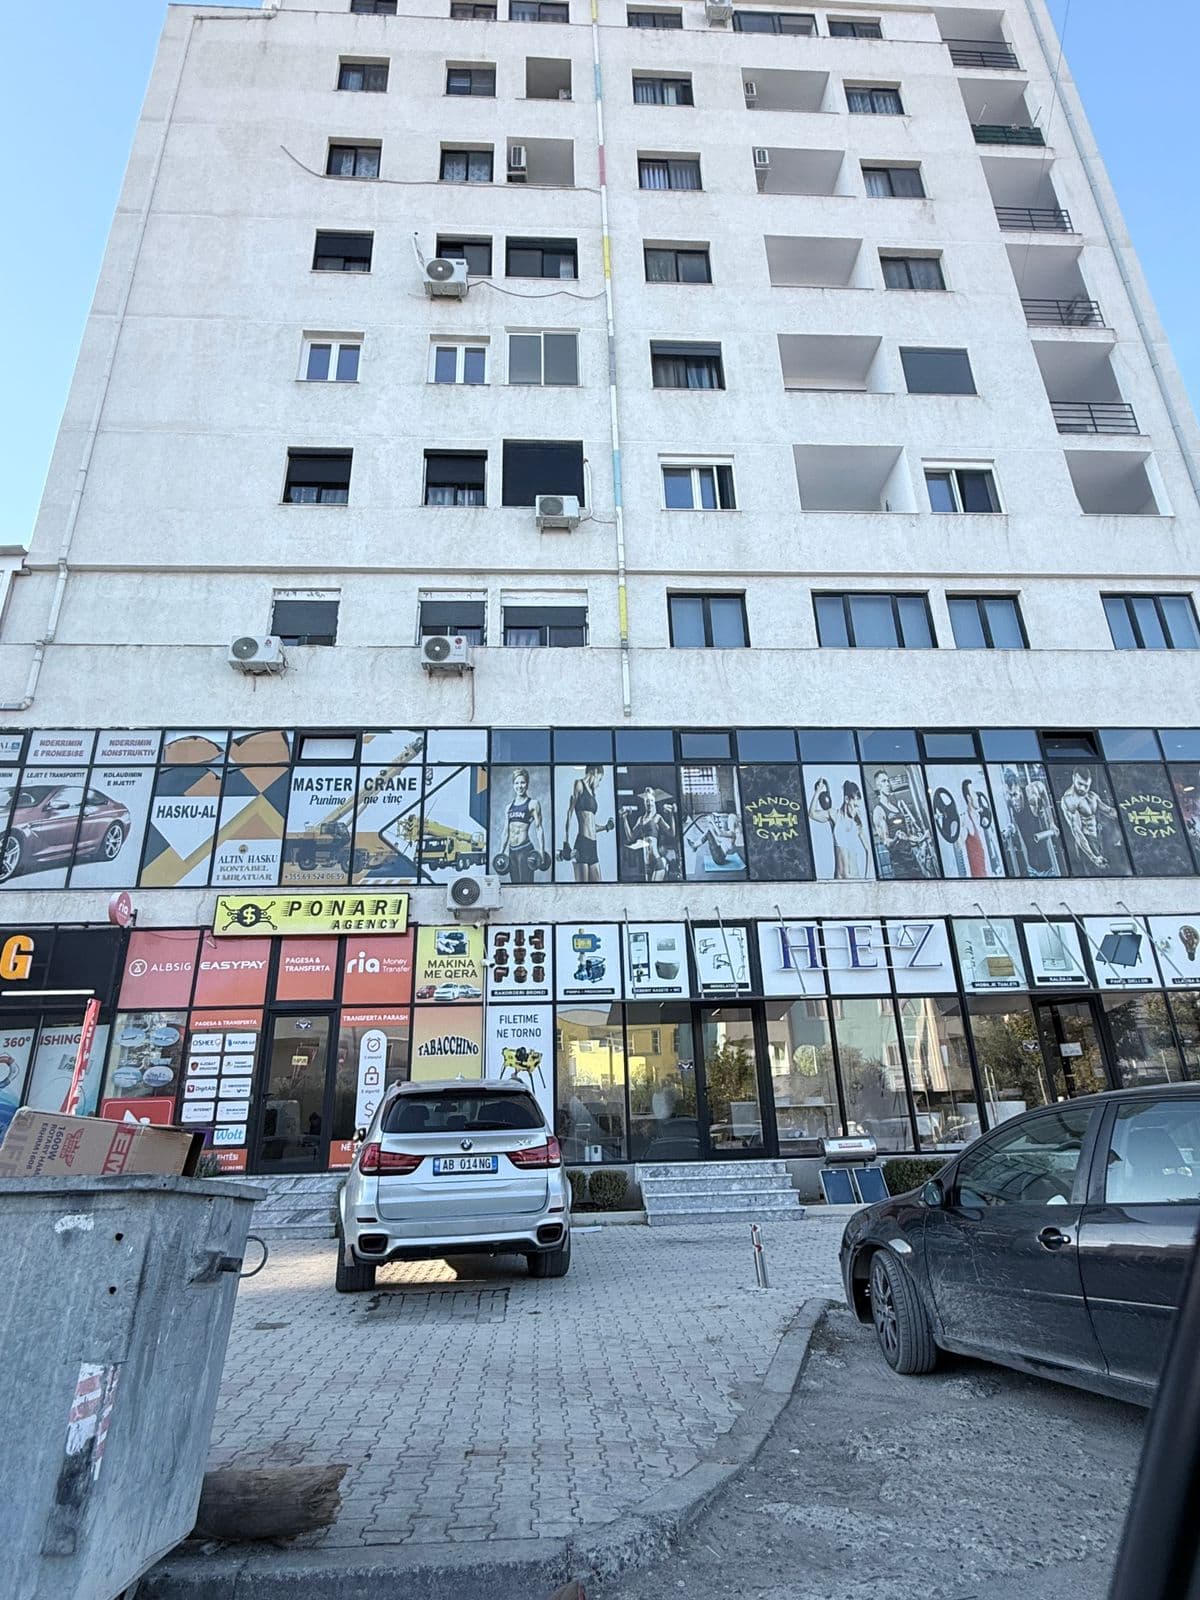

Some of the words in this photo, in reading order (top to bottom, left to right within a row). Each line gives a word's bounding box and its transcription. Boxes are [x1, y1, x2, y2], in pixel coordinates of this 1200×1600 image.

[293, 777, 353, 791] MASTER
[363, 777, 417, 791] CRANE
[309, 794, 347, 805] Punime
[745, 796, 801, 812] NANDO
[1118, 795, 1174, 810] NANDO
[156, 805, 217, 819] HASKU-AL
[756, 828, 799, 841] GYM
[1133, 825, 1177, 838] GYM
[218, 855, 243, 864] ALTIN
[247, 854, 278, 864] HASKU
[281, 899, 403, 917] PONARI
[331, 919, 399, 930] AGENCY
[150, 962, 192, 972] ALBSIG
[200, 960, 267, 970] EASYPAY
[347, 951, 381, 973] ria
[383, 957, 407, 966] Money
[427, 959, 475, 969] MAKINA
[383, 965, 410, 973] Transfer
[424, 970, 442, 979] ME
[444, 969, 478, 979] QERA
[499, 1014, 539, 1024] FILETIME
[497, 1028, 509, 1038] NE
[512, 1027, 542, 1038] TORNO
[40, 1034, 81, 1046] ISHING
[418, 1036, 479, 1056] TABACCHINO
[41, 1123, 57, 1155] ROTARY
[216, 1129, 244, 1140] Wolt
[47, 1126, 66, 1161] 1600W
[442, 1160, 455, 1170] AB
